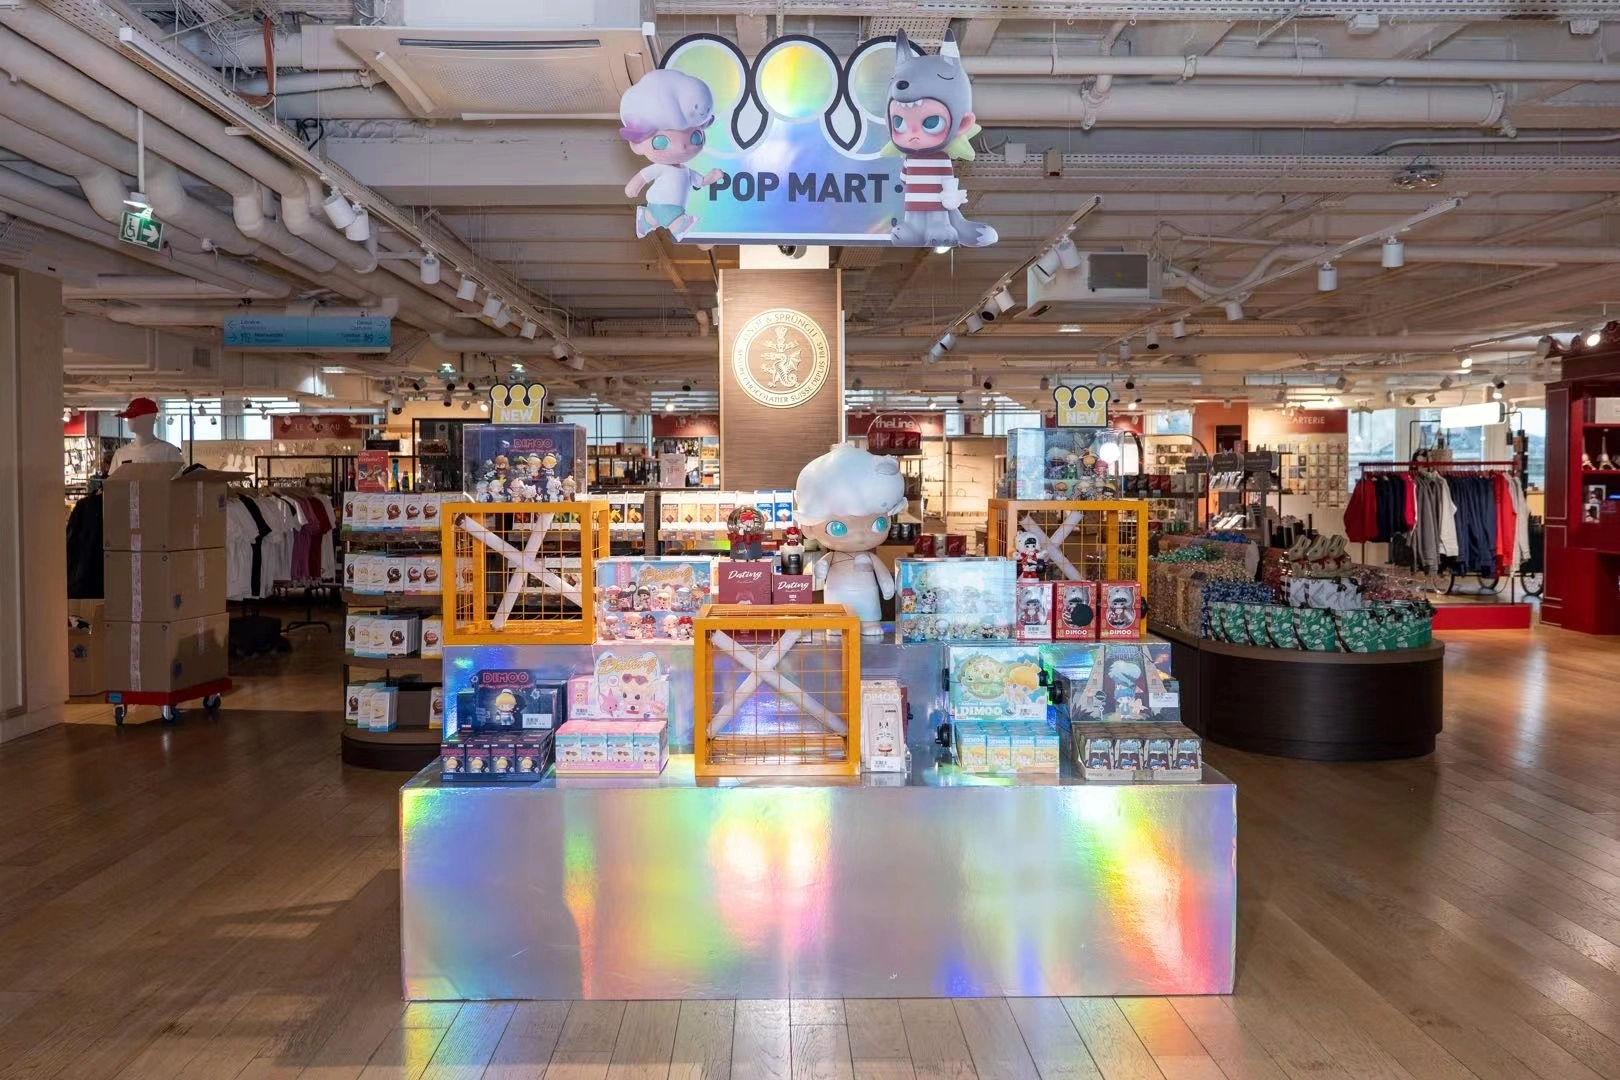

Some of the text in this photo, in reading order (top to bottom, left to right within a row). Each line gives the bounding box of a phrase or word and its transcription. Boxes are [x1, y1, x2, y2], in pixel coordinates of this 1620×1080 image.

[709, 172, 889, 203] POP MART
[774, 313, 818, 337] SPRÜNGLI
[817, 342, 826, 358] 1845
[812, 361, 825, 386] DEPUIS
[743, 376, 788, 403] CHOCOLATIER
[790, 386, 814, 401] SUISSE
[501, 409, 533, 422] NEW
[1066, 411, 1099, 424] NEW
[875, 417, 914, 428] theLine
[513, 438, 553, 448] DIMOO
[728, 570, 762, 580] Dating
[778, 581, 809, 590] Dating
[483, 672, 529, 683] DIMOO
[960, 706, 1003, 716] DIMOO
